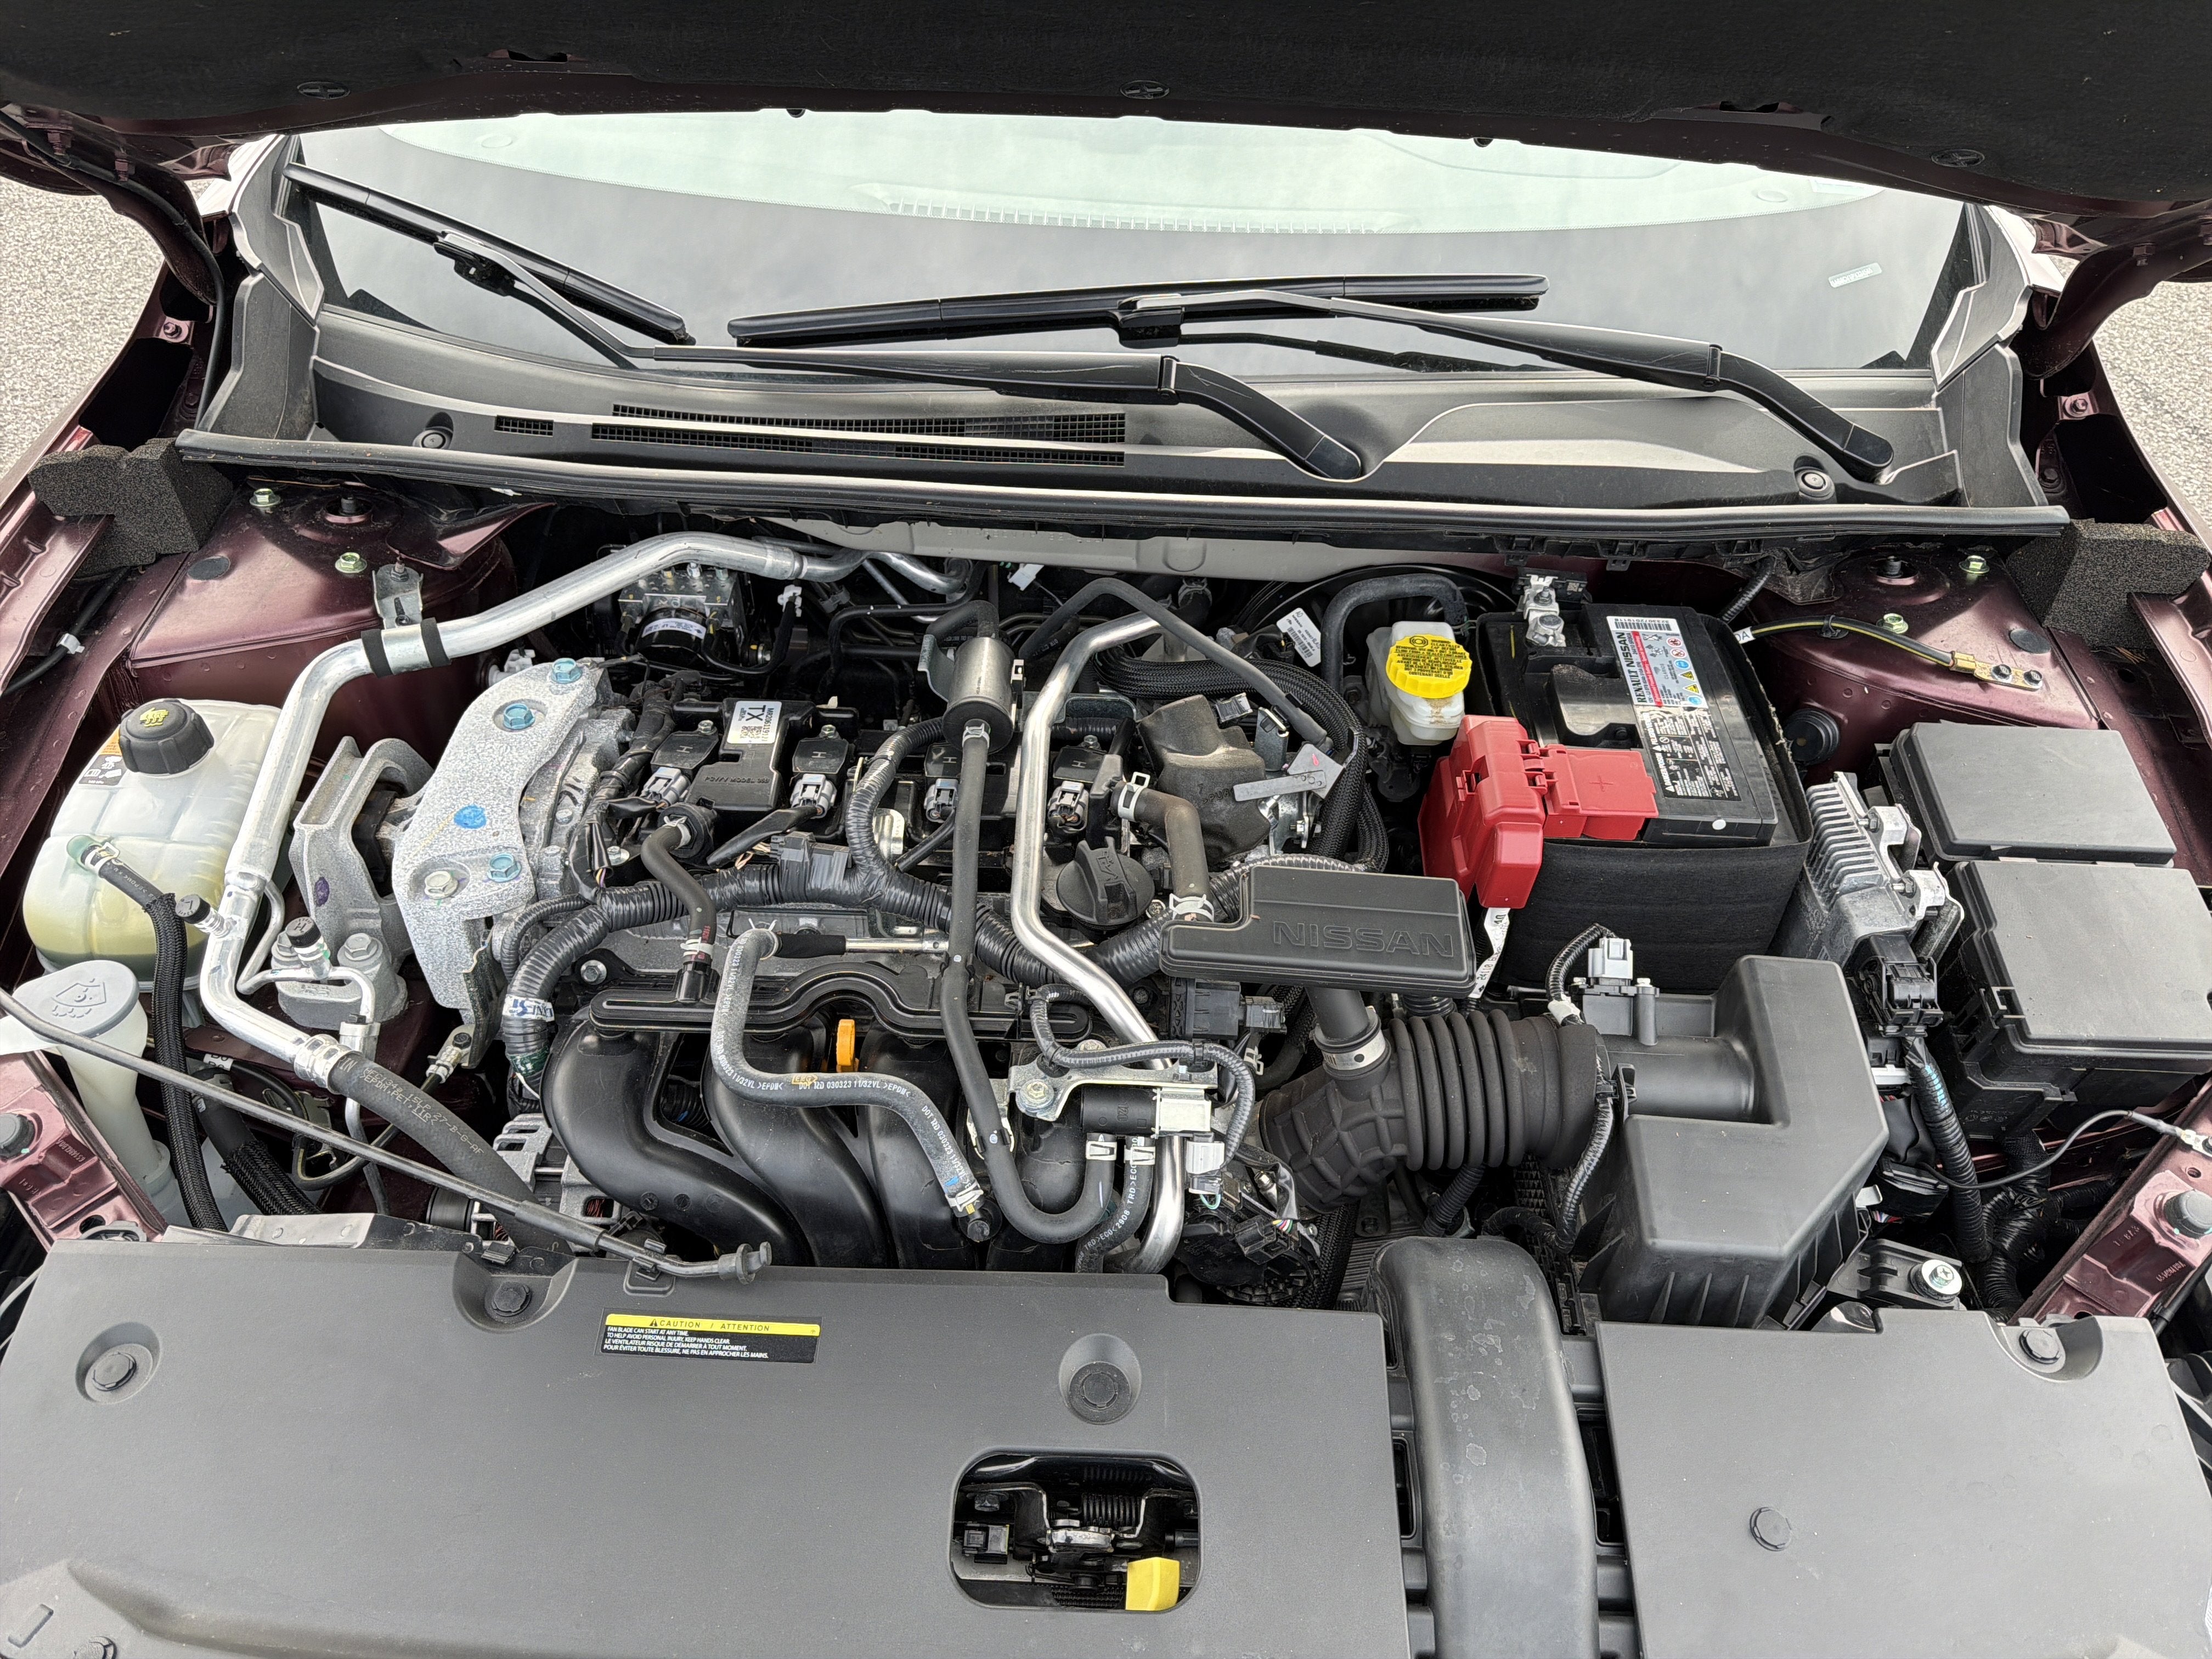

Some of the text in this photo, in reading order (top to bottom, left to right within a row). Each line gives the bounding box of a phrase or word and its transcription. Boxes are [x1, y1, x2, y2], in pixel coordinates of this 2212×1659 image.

[1616, 632, 1647, 703] RENAULT NISSAN
[746, 705, 766, 721] TX
[1274, 921, 1454, 957] NISSAN
[718, 1055, 735, 1077] 030323
[731, 1070, 756, 1090] 11/32VL
[826, 1080, 852, 1089] 030323
[854, 1080, 881, 1089] 11/32VL
[408, 1093, 431, 1110] 15LP
[433, 1112, 485, 1155] 27-B-G-AF
[921, 1105, 934, 1119] DOT
[937, 1130, 953, 1155] 030323
